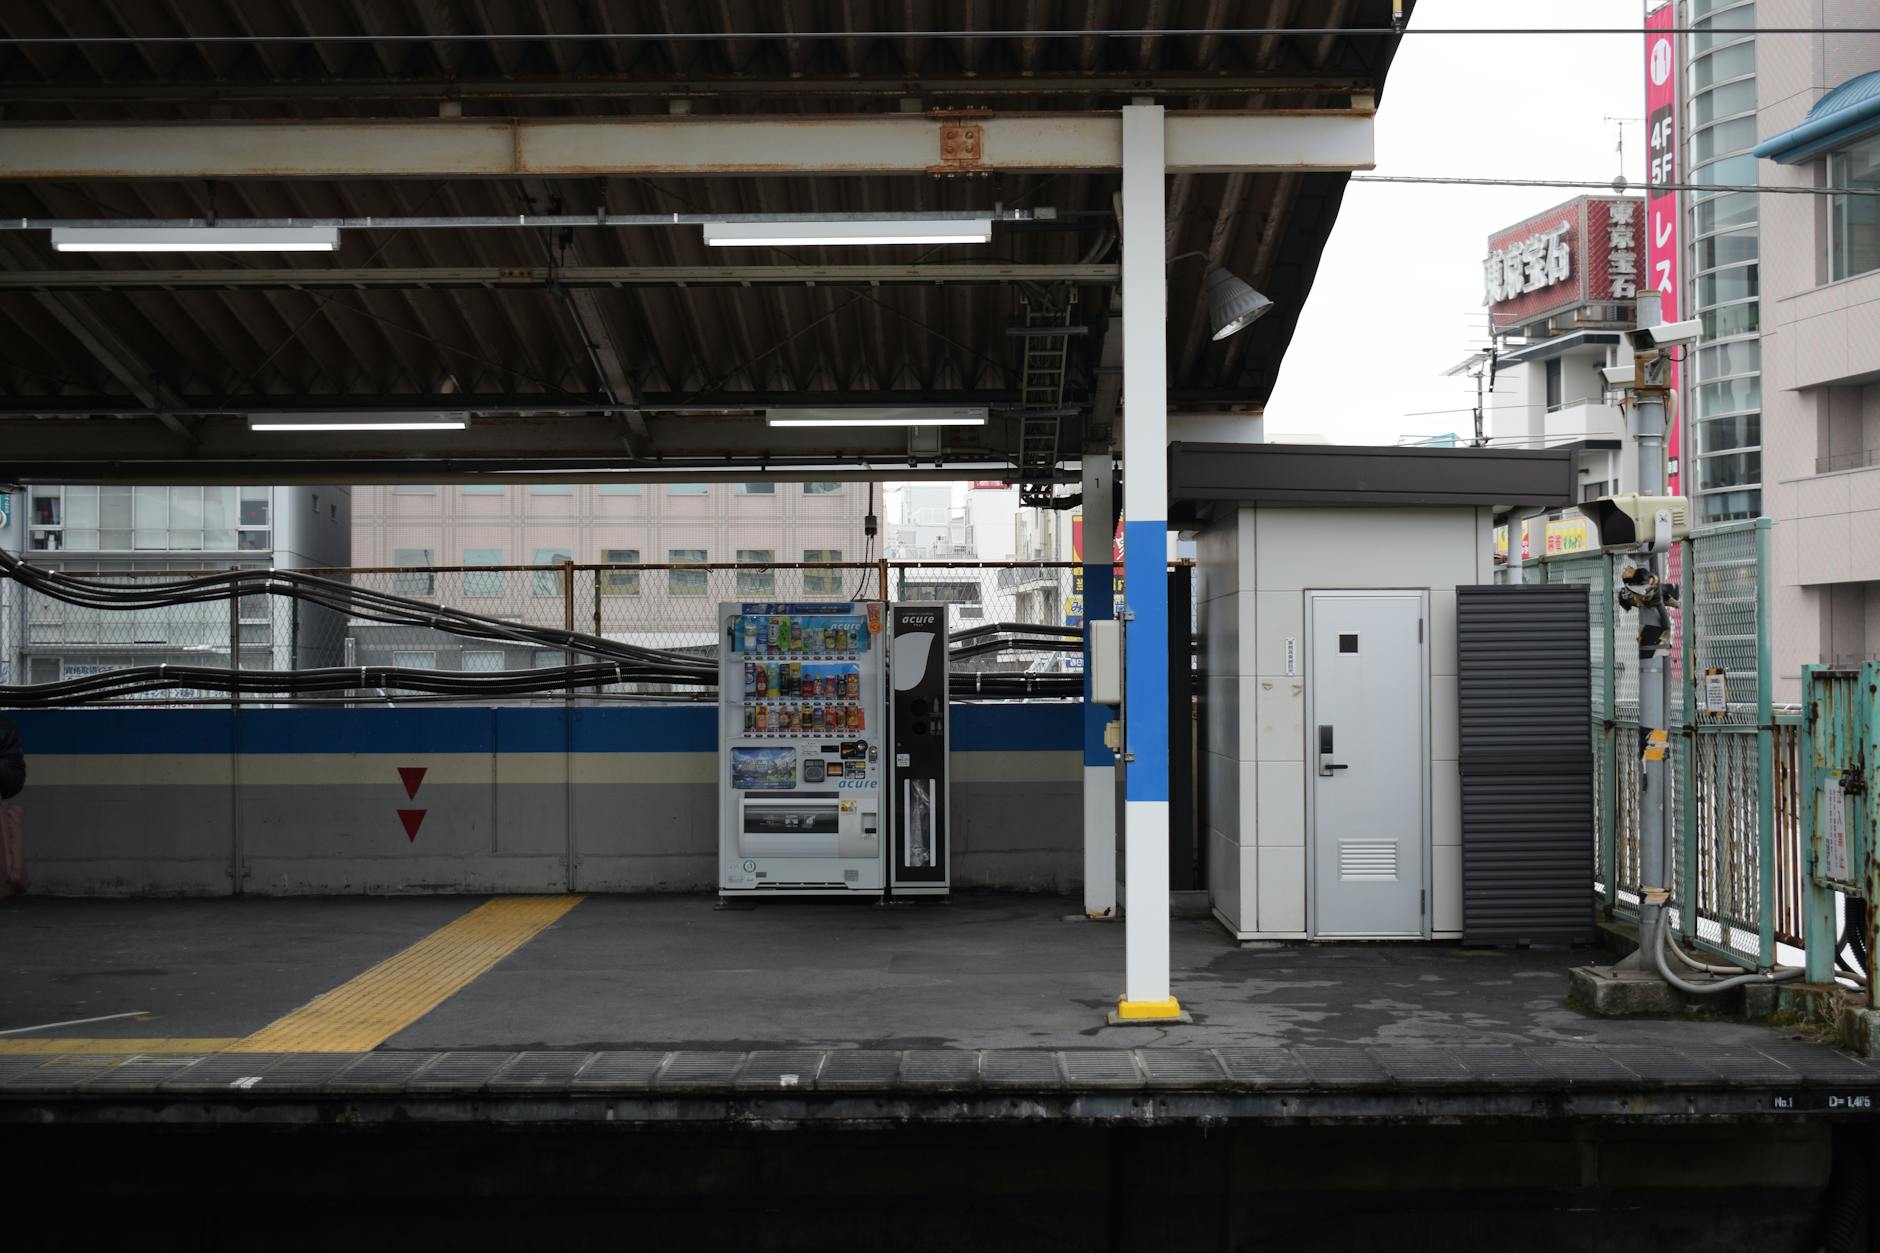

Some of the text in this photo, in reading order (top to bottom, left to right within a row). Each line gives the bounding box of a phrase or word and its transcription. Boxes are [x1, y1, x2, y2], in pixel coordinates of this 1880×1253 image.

[1651, 117, 1673, 150] 4F
[1651, 152, 1673, 185] 5F
[1606, 201, 1638, 298] 東京宝石
[1482, 220, 1570, 307] 東京宝石
[1094, 478, 1100, 489] 1
[902, 615, 935, 624] acure
[838, 780, 878, 789] acure
[1775, 1097, 1793, 1108] No.1
